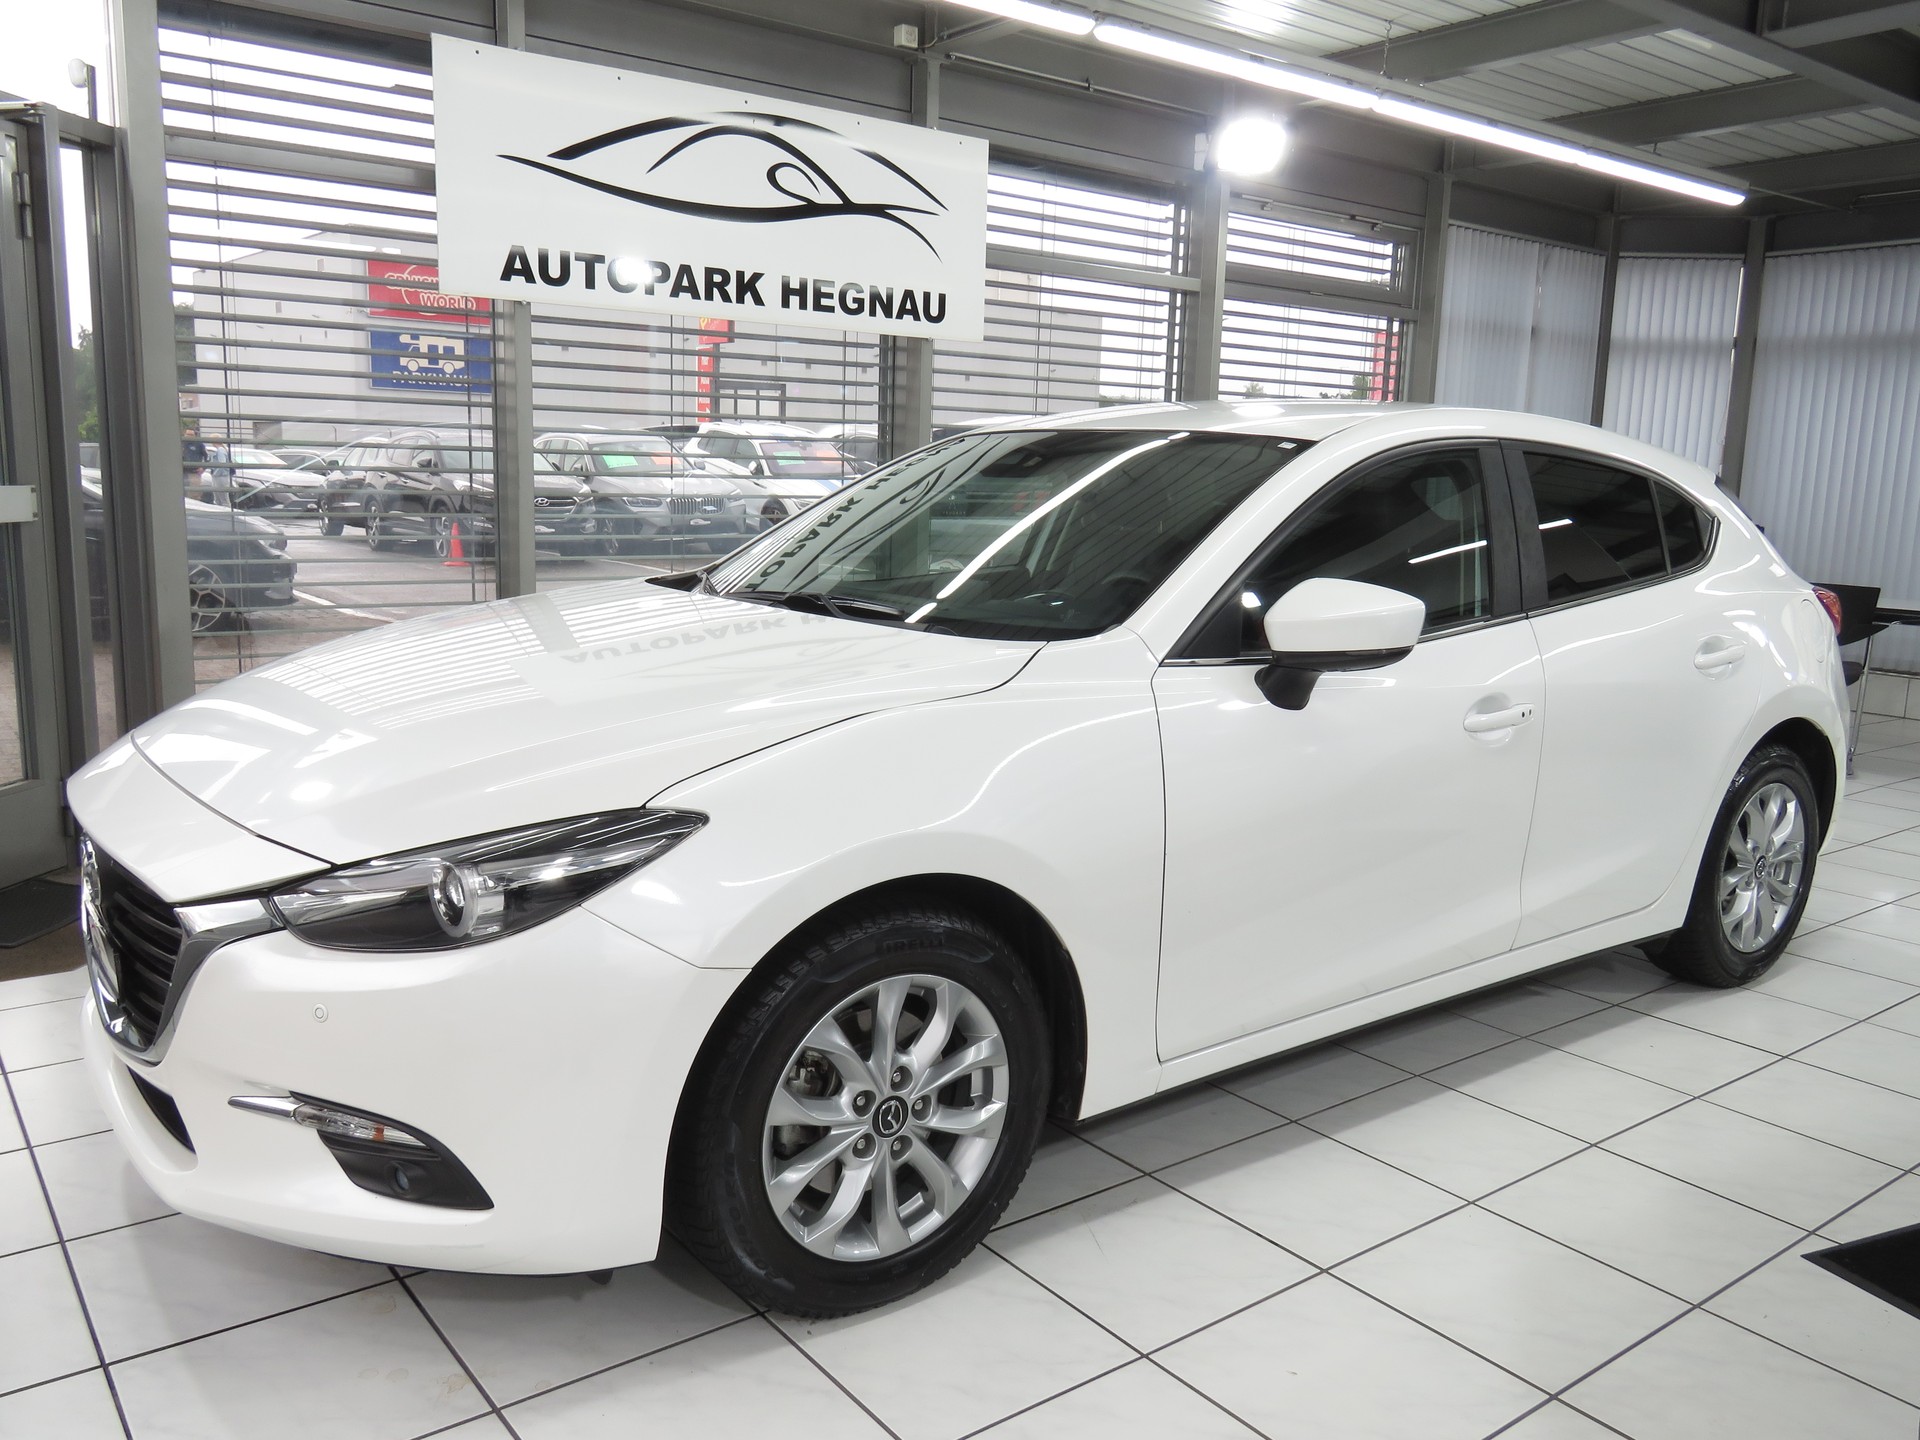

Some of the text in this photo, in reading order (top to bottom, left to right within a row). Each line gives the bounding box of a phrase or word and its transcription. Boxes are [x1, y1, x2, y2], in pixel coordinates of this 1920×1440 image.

[419, 292, 477, 311] WORLD
[500, 244, 947, 324] AUTOPARK HEGNAU
